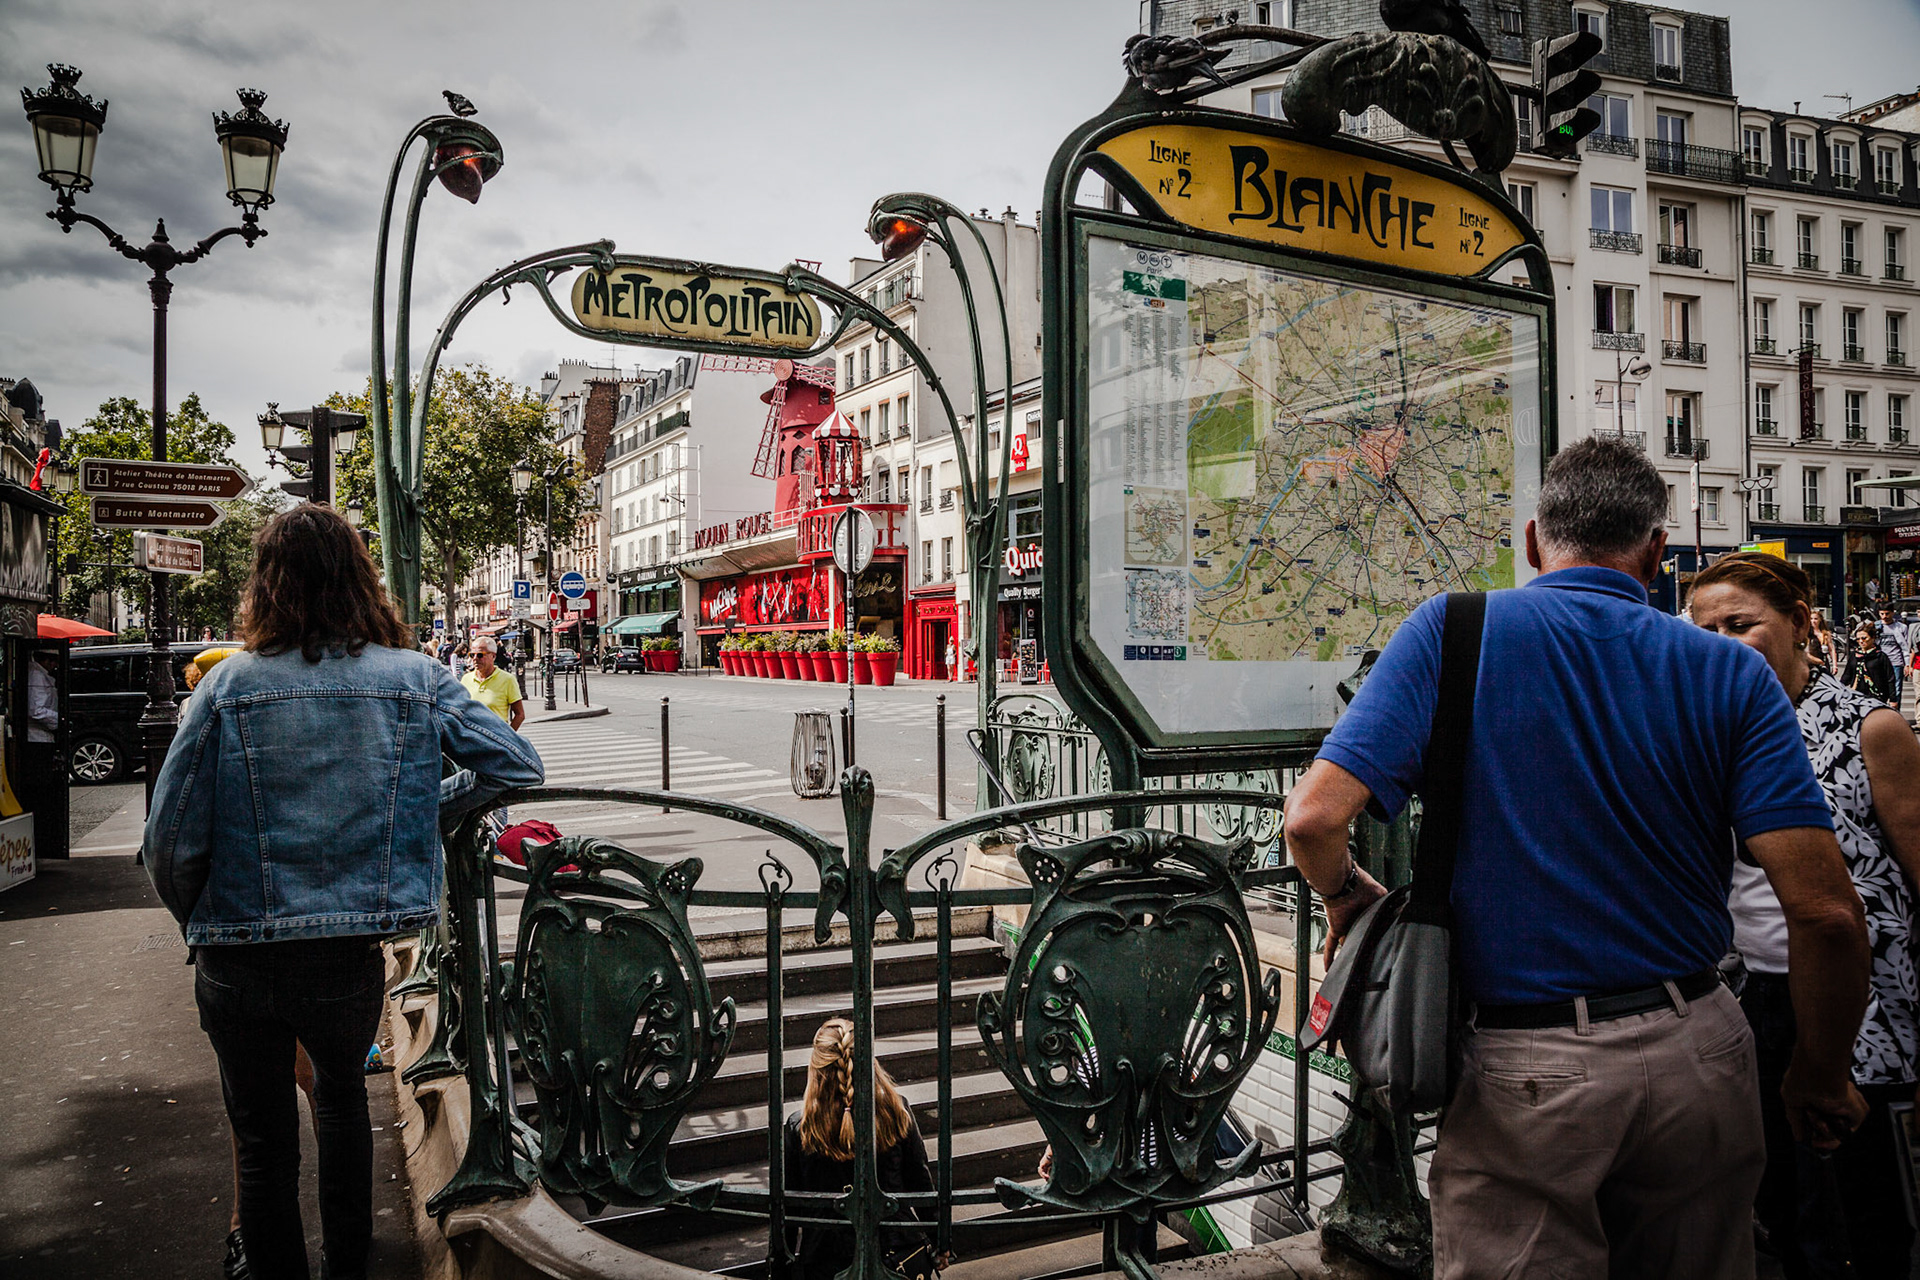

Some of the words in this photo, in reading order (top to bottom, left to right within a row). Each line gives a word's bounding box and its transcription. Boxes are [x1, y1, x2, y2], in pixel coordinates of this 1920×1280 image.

[1177, 168, 1192, 200] 2
[1229, 145, 1435, 251] BLANCHE
[1473, 230, 1485, 257] 2
[582, 272, 813, 338] METROPOLITAIN
[114, 469, 141, 477] Atelier
[144, 470, 173, 479] Théâtre
[187, 473, 231, 482] Montmartre
[198, 484, 221, 492] PARIS
[115, 508, 143, 518] Butte
[147, 510, 206, 519] Montmartre
[694, 522, 729, 550] MOULIN
[736, 511, 772, 540] ROUGE
[1003, 586, 1022, 599] Quality
[1023, 586, 1041, 597] Burger
